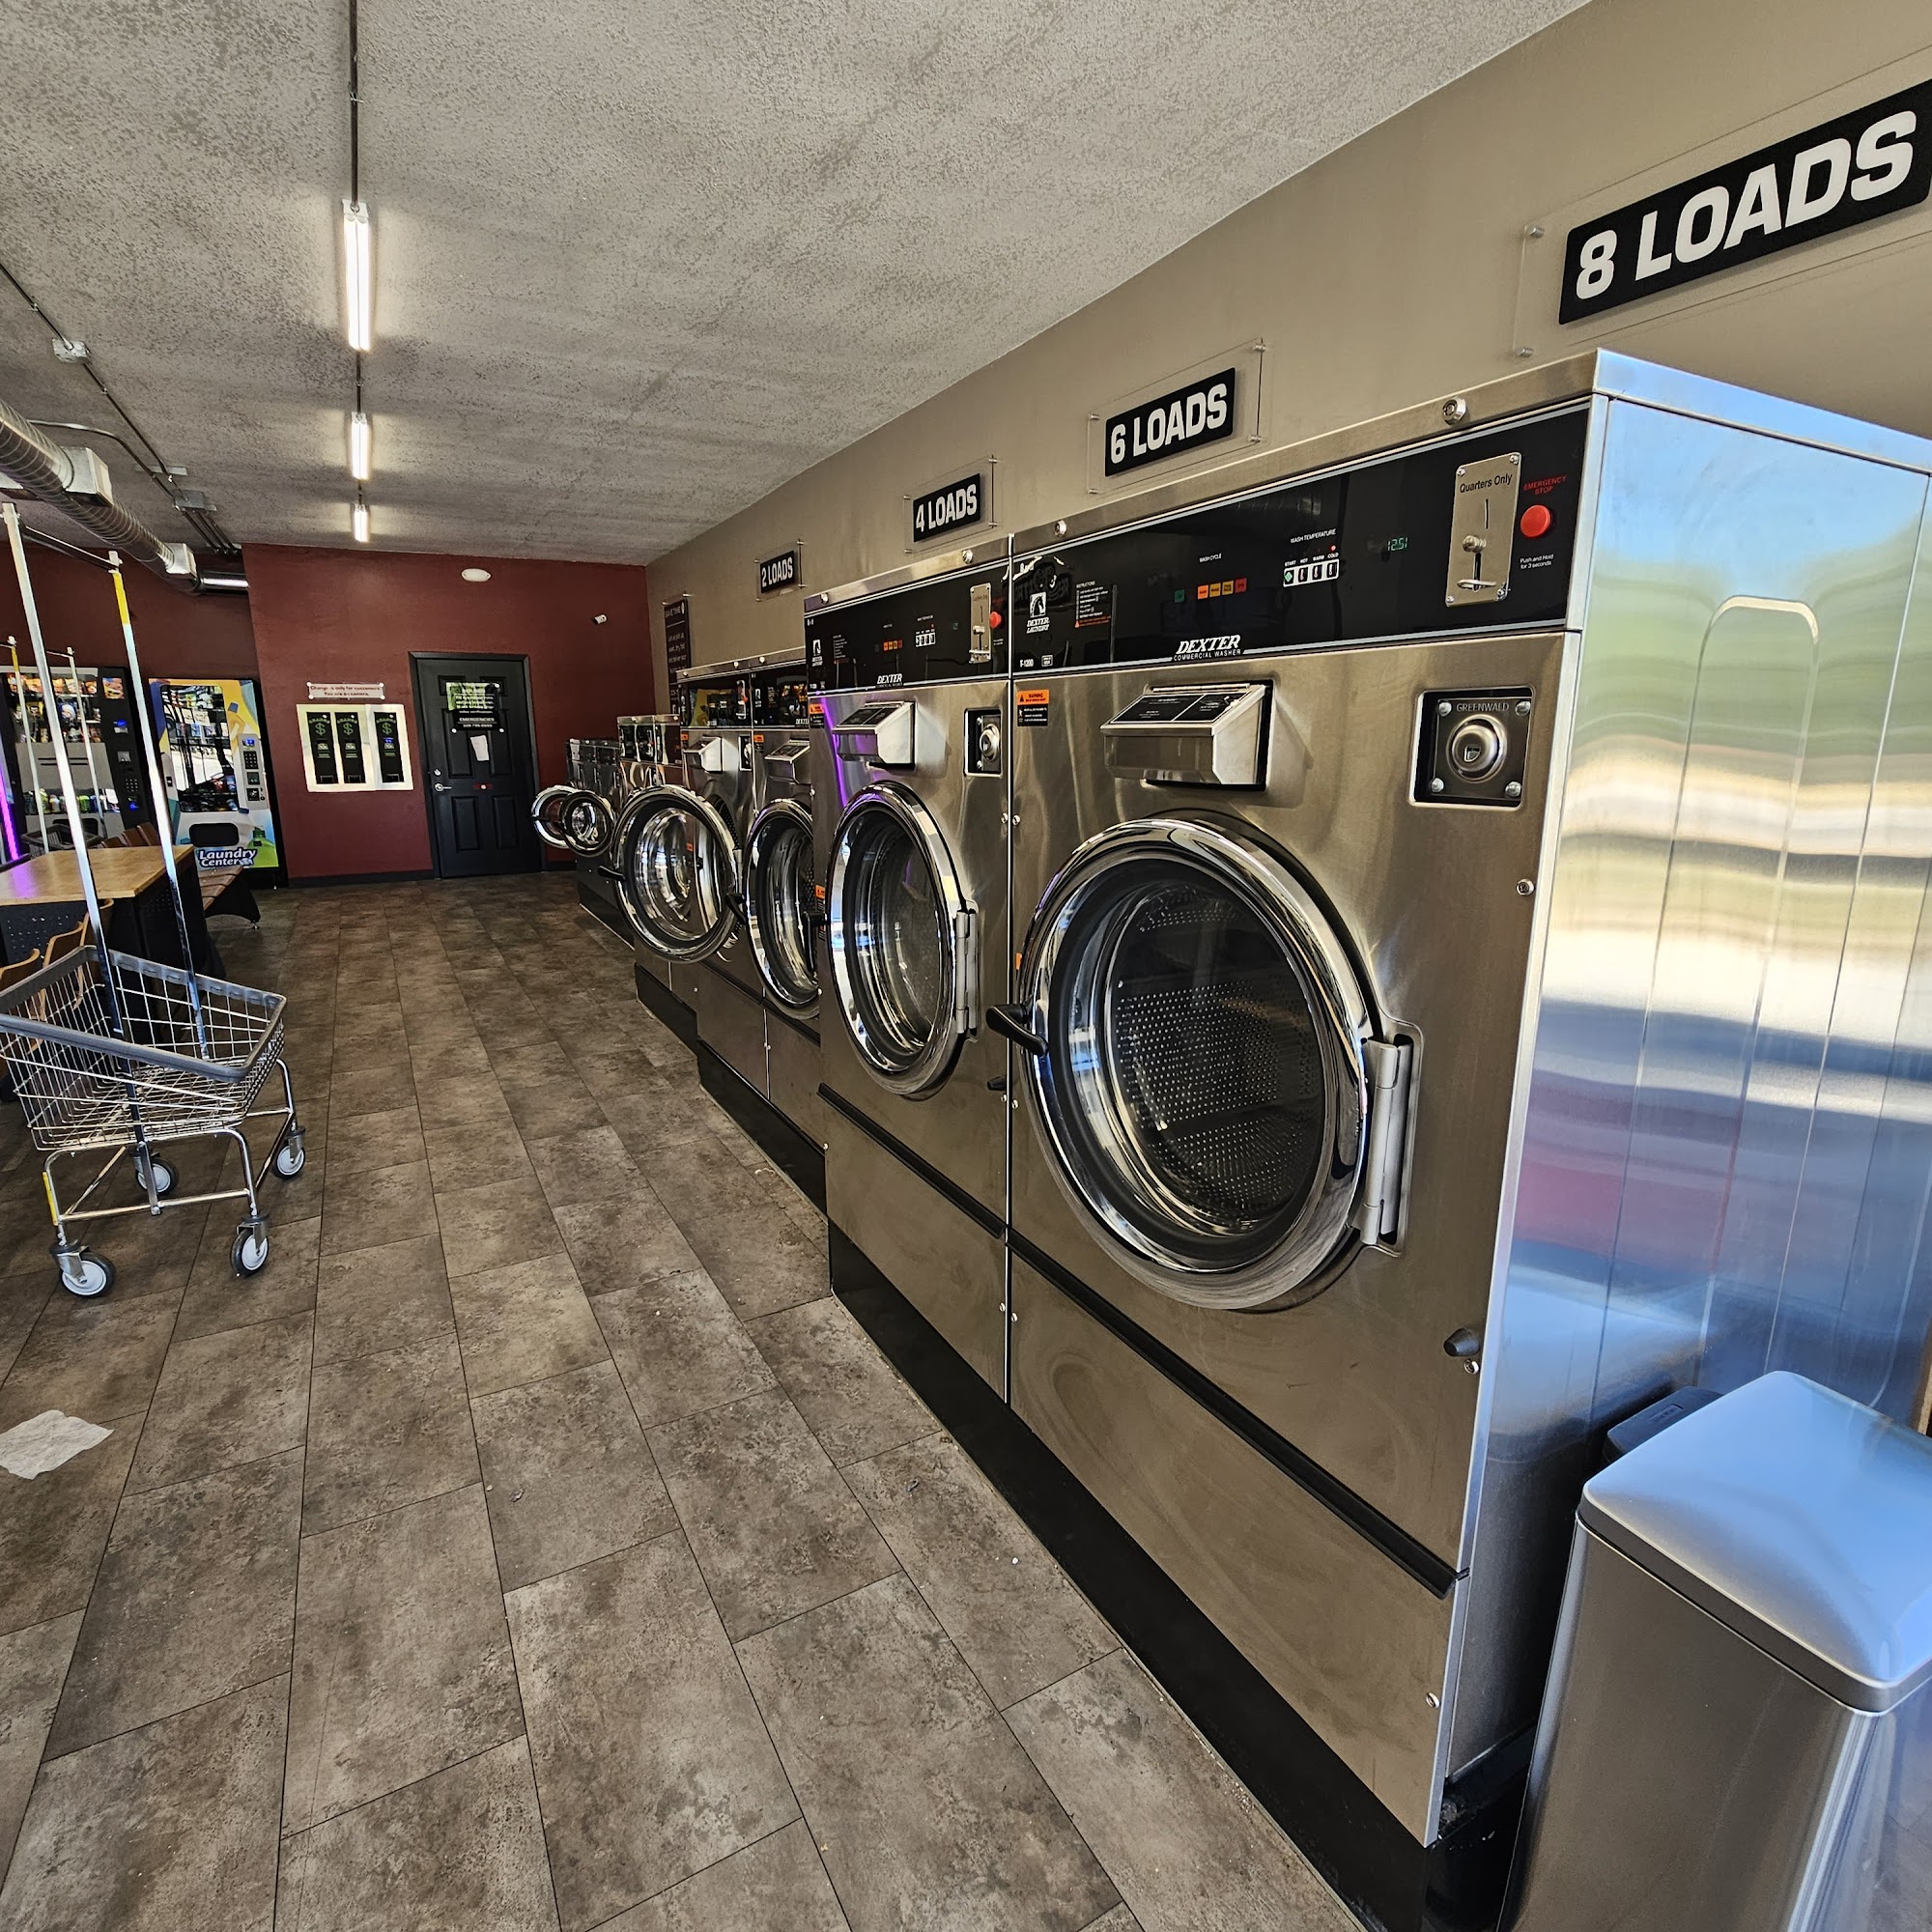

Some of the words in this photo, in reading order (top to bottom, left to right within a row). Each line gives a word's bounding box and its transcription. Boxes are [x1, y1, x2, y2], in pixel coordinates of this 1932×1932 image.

[1576, 229, 1617, 300] 8
[1635, 110, 1917, 281] LOADS
[1111, 423, 1126, 464] 6
[1133, 383, 1228, 457] LOADS
[1460, 479, 1492, 494] Quarters
[1493, 473, 1513, 486] Only
[1523, 474, 1568, 491] EMERGENCY
[1534, 485, 1554, 496] STOP
[916, 503, 924, 533] 4
[928, 483, 978, 530] LOADS
[761, 567, 767, 587] 2
[767, 556, 793, 585] LOADS
[1176, 635, 1241, 654] DEXTER
[1174, 652, 1212, 662] COMMERCIAL
[1214, 648, 1241, 658] WASHER
[877, 673, 902, 684] DEXTER
[1456, 702, 1510, 712] GREENWALD
[199, 847, 257, 860] Laundry
[200, 858, 240, 867] Center
